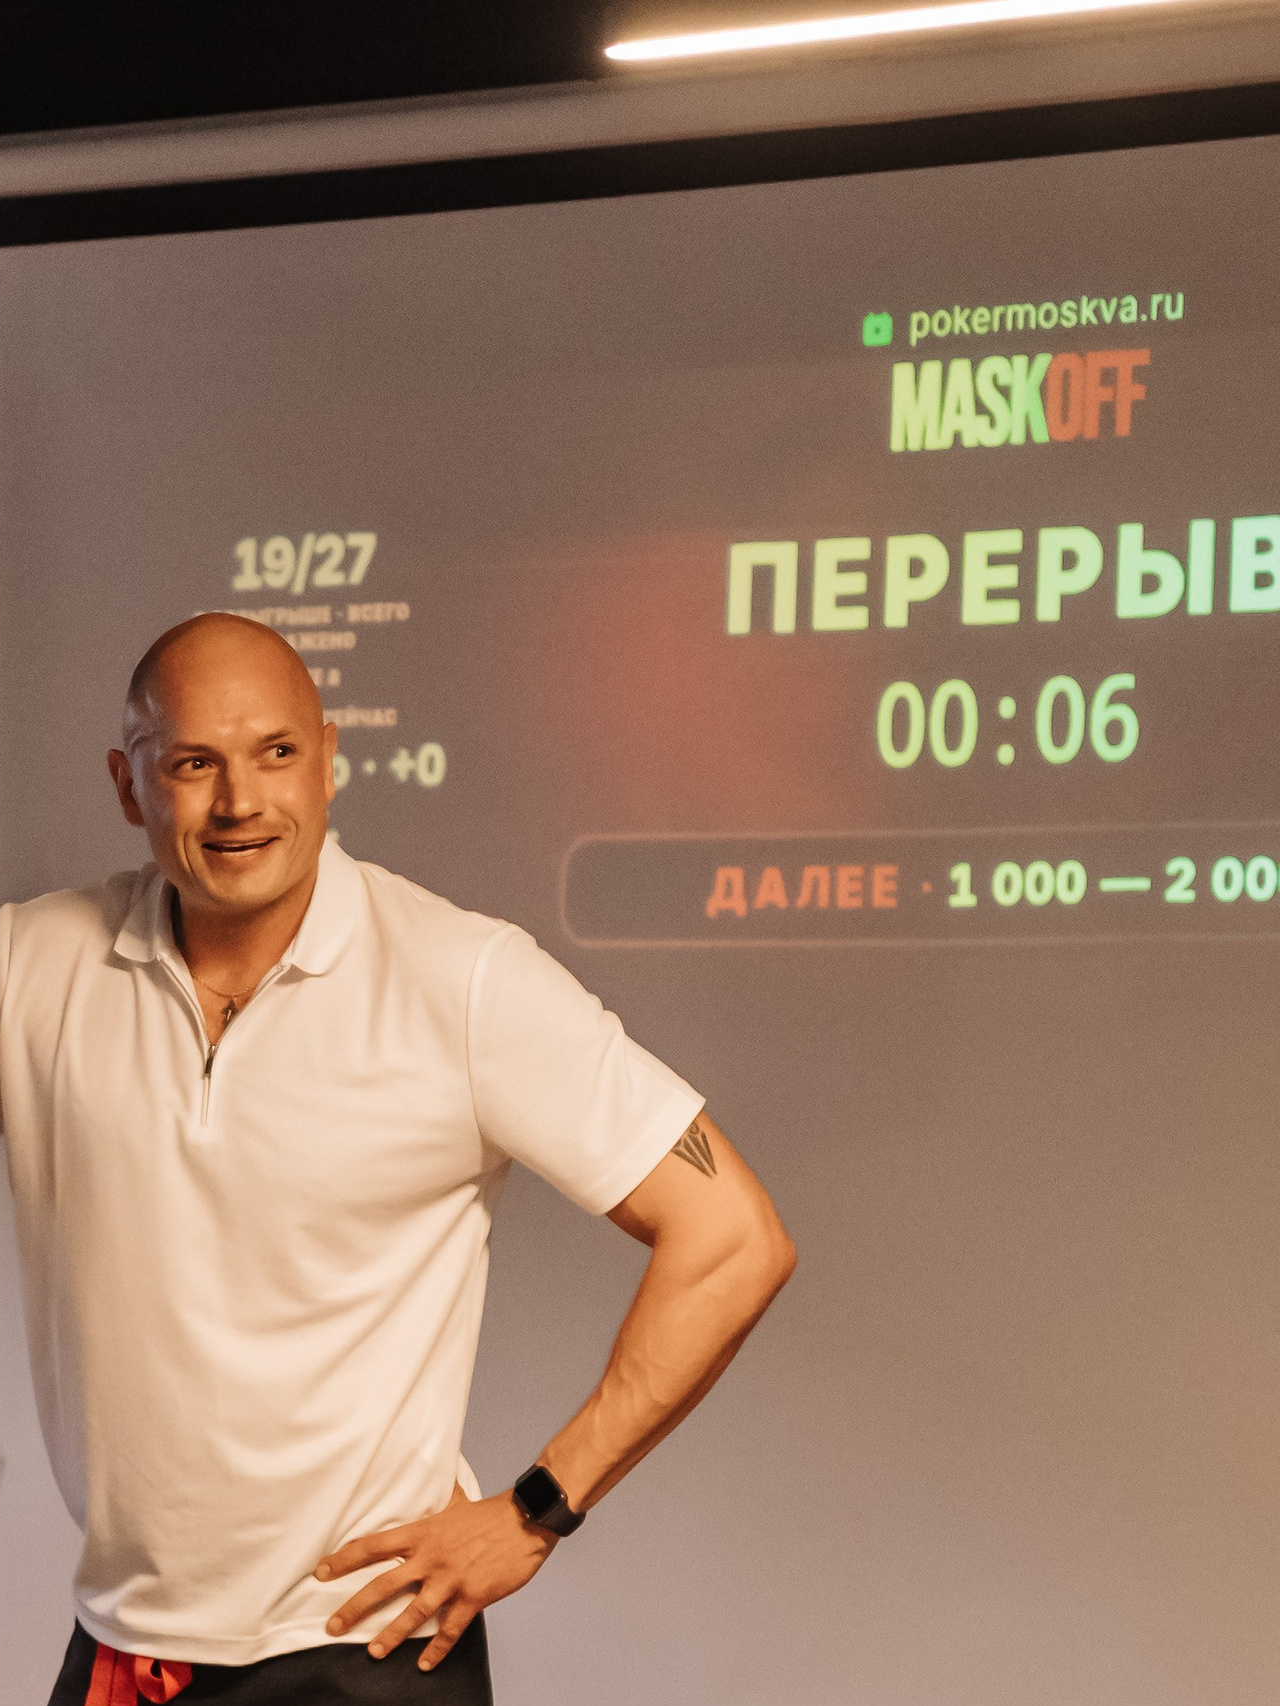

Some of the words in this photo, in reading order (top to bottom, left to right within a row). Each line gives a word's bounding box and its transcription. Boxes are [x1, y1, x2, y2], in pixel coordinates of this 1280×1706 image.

[909, 291, 1185, 347] pokermoskva.ru
[231, 531, 378, 595] 19/27
[727, 514, 1280, 636] ПЕРЕРЫВ
[877, 673, 1141, 769] 00:06
[705, 864, 899, 918] ДАЛЕЕ
[948, 862, 978, 908] 1
[992, 858, 1089, 906] 000
[1164, 855, 1197, 904] 2
[1210, 854, 1280, 903] 00
